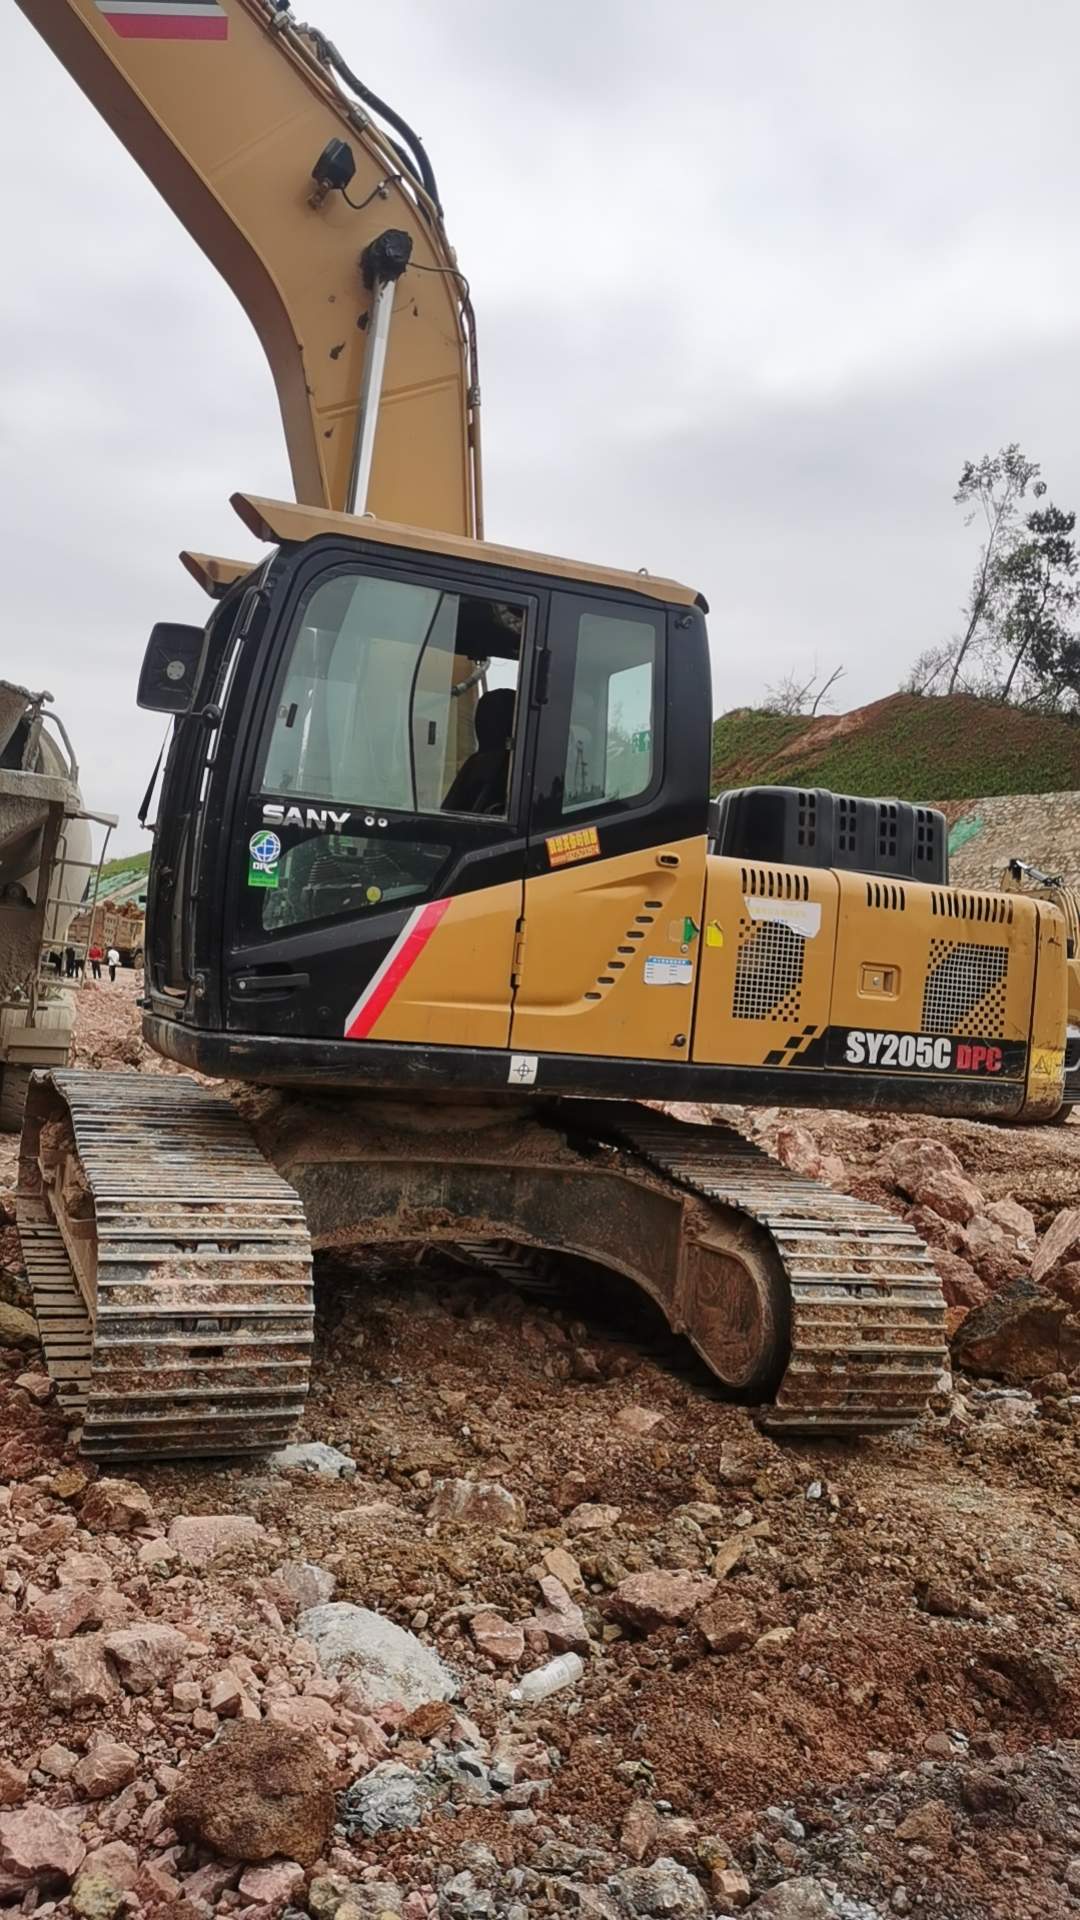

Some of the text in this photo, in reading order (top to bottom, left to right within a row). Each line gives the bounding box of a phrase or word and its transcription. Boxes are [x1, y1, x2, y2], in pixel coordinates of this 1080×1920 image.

[263, 804, 351, 832] SANY
[845, 1031, 1002, 1072] SY205C DPC
